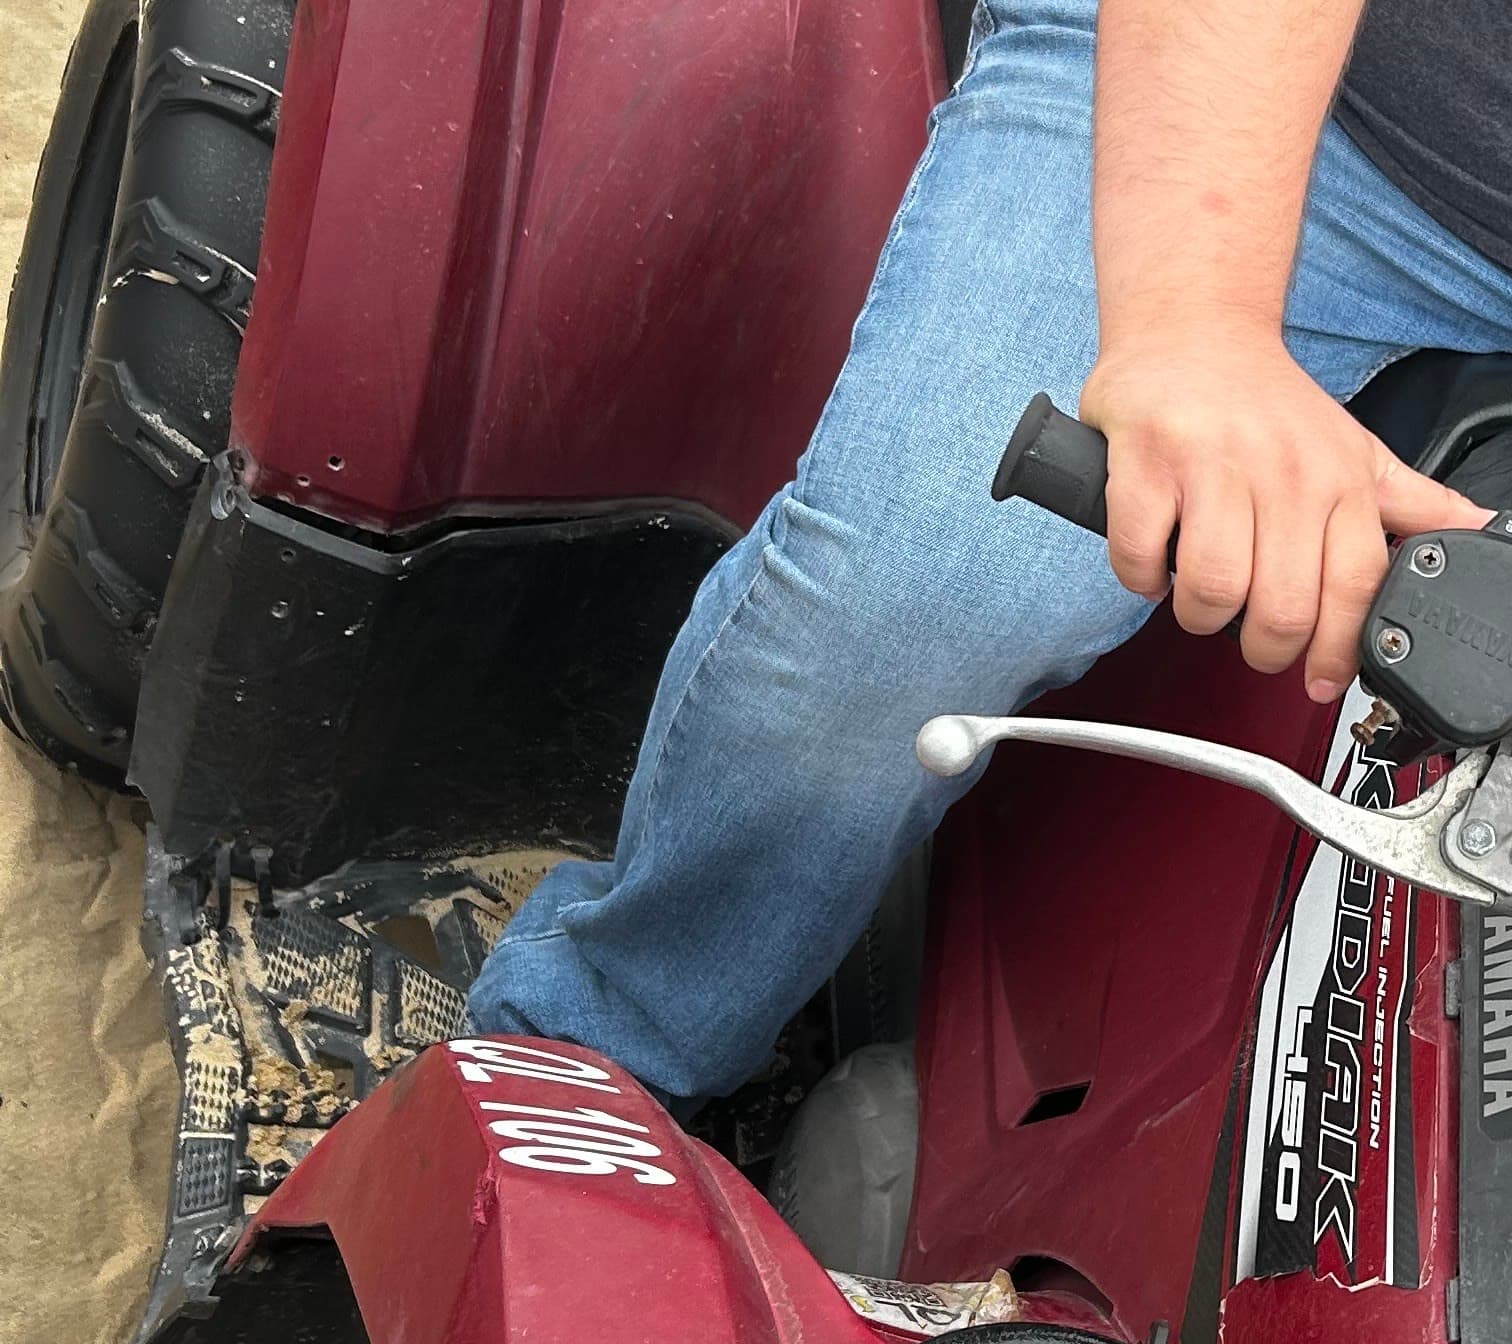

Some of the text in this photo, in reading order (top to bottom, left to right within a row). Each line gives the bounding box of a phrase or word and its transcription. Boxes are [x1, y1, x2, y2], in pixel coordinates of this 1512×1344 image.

[448, 1040, 677, 1185] QL 106
[1275, 1006, 1313, 1222] 450
[1368, 873, 1395, 1150] FUEL INJECTION
